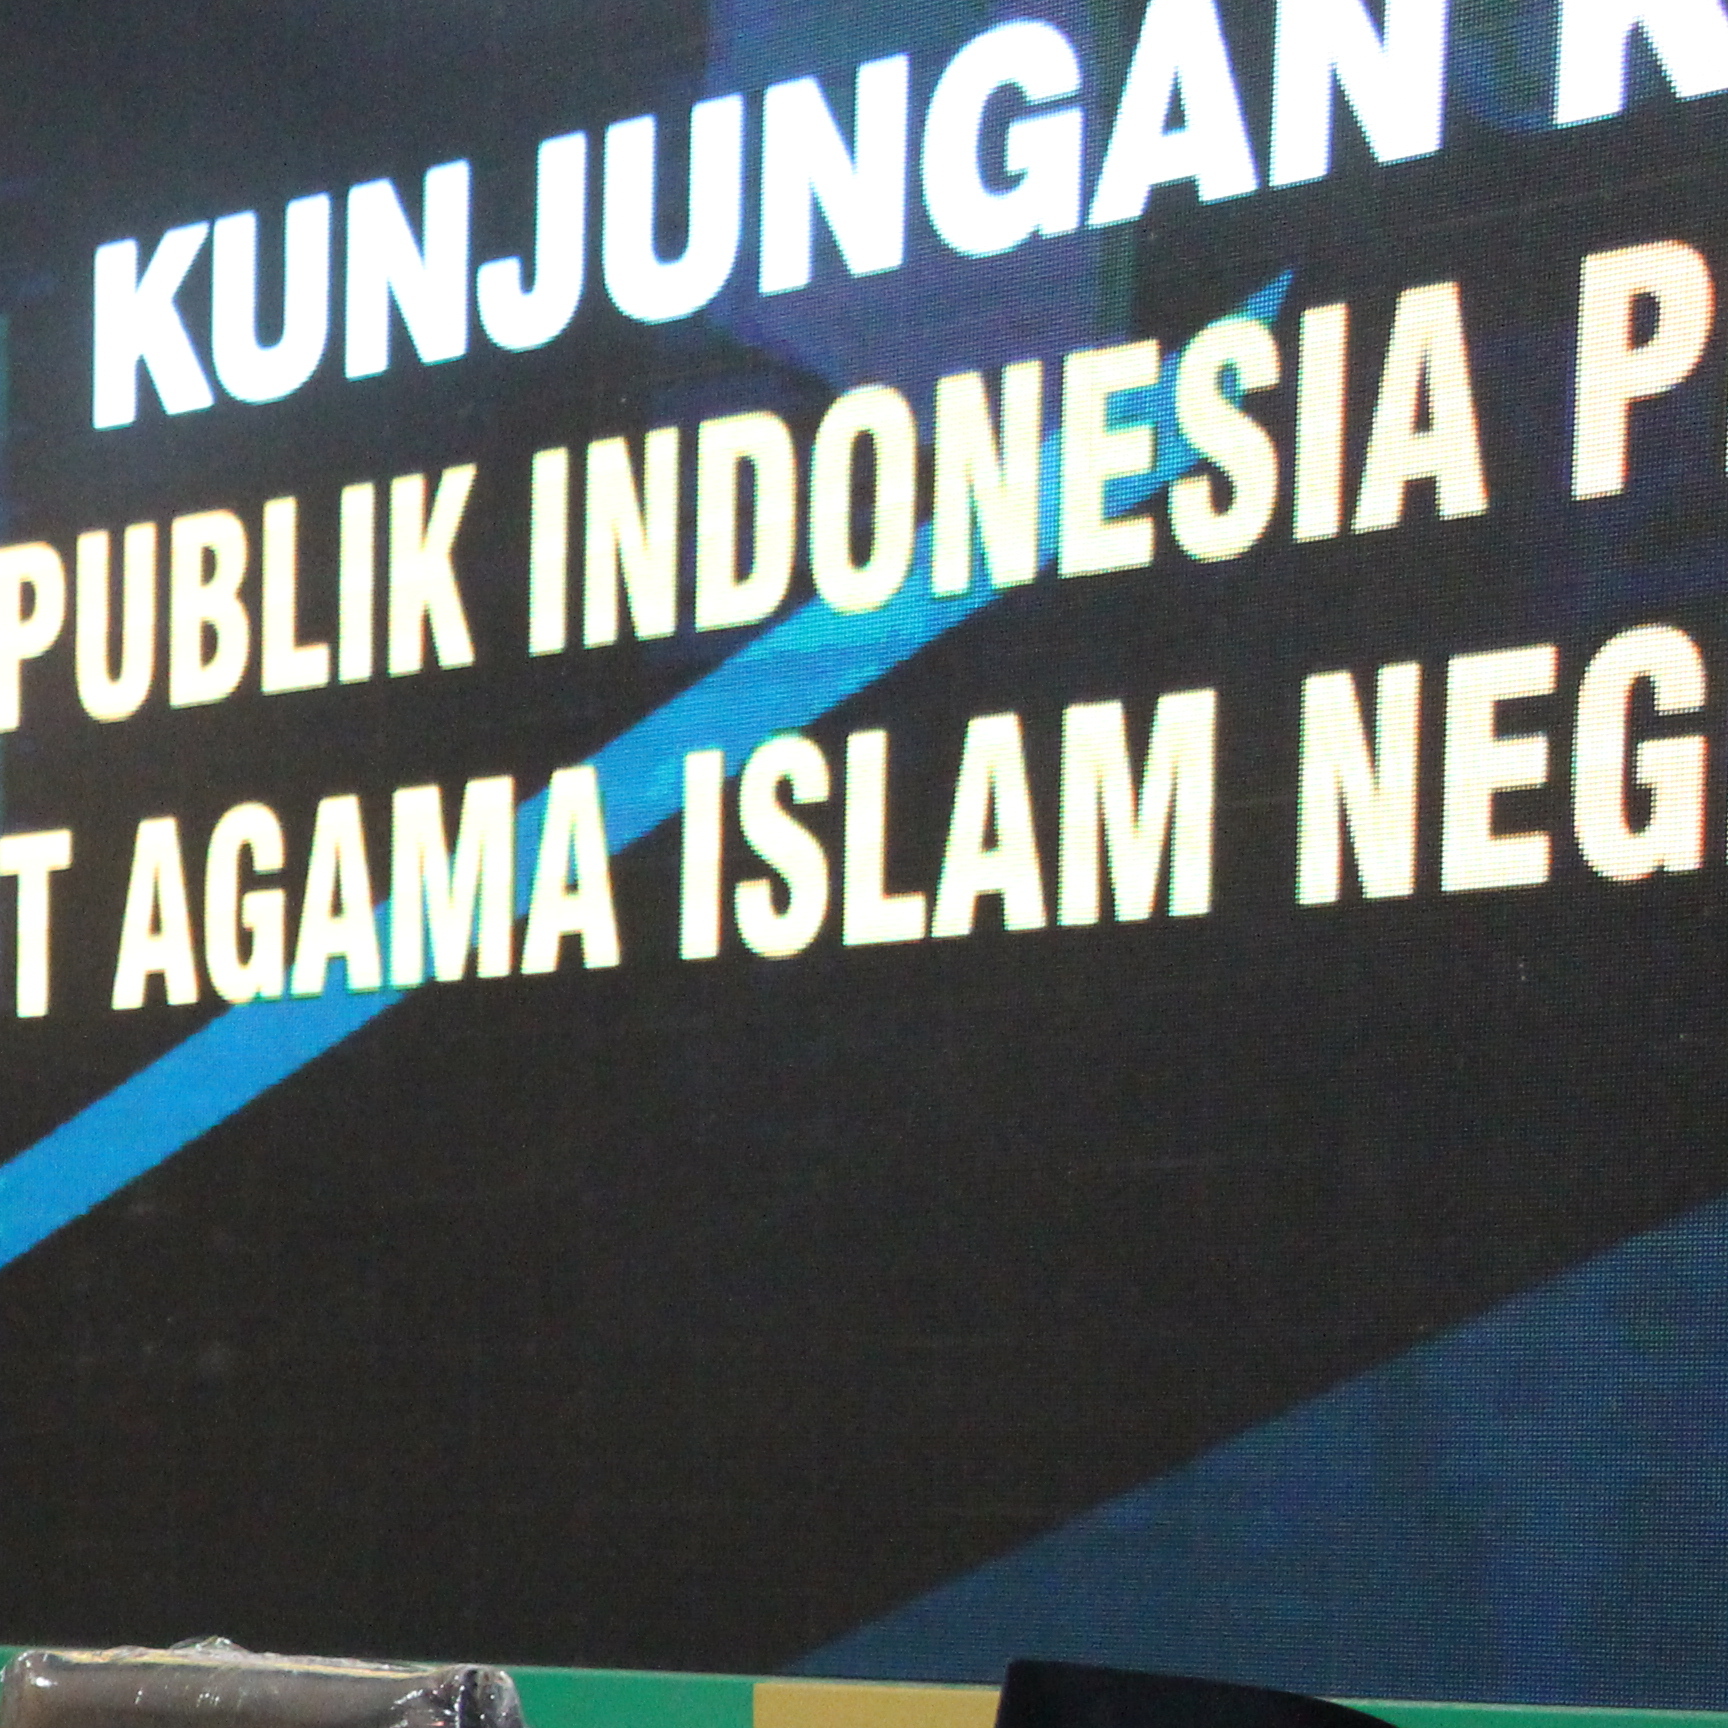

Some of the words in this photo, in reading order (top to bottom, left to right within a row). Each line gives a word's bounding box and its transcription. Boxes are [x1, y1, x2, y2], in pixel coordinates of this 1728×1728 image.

[92, 0, 1450, 430] KUNJUNGAN
[527, 280, 1490, 658] INDONESIA
[1570, 239, 1728, 501] P
[110, 764, 622, 1012] AGAMA
[679, 687, 1218, 961] ISLAM
[1294, 622, 1707, 906] NEG
